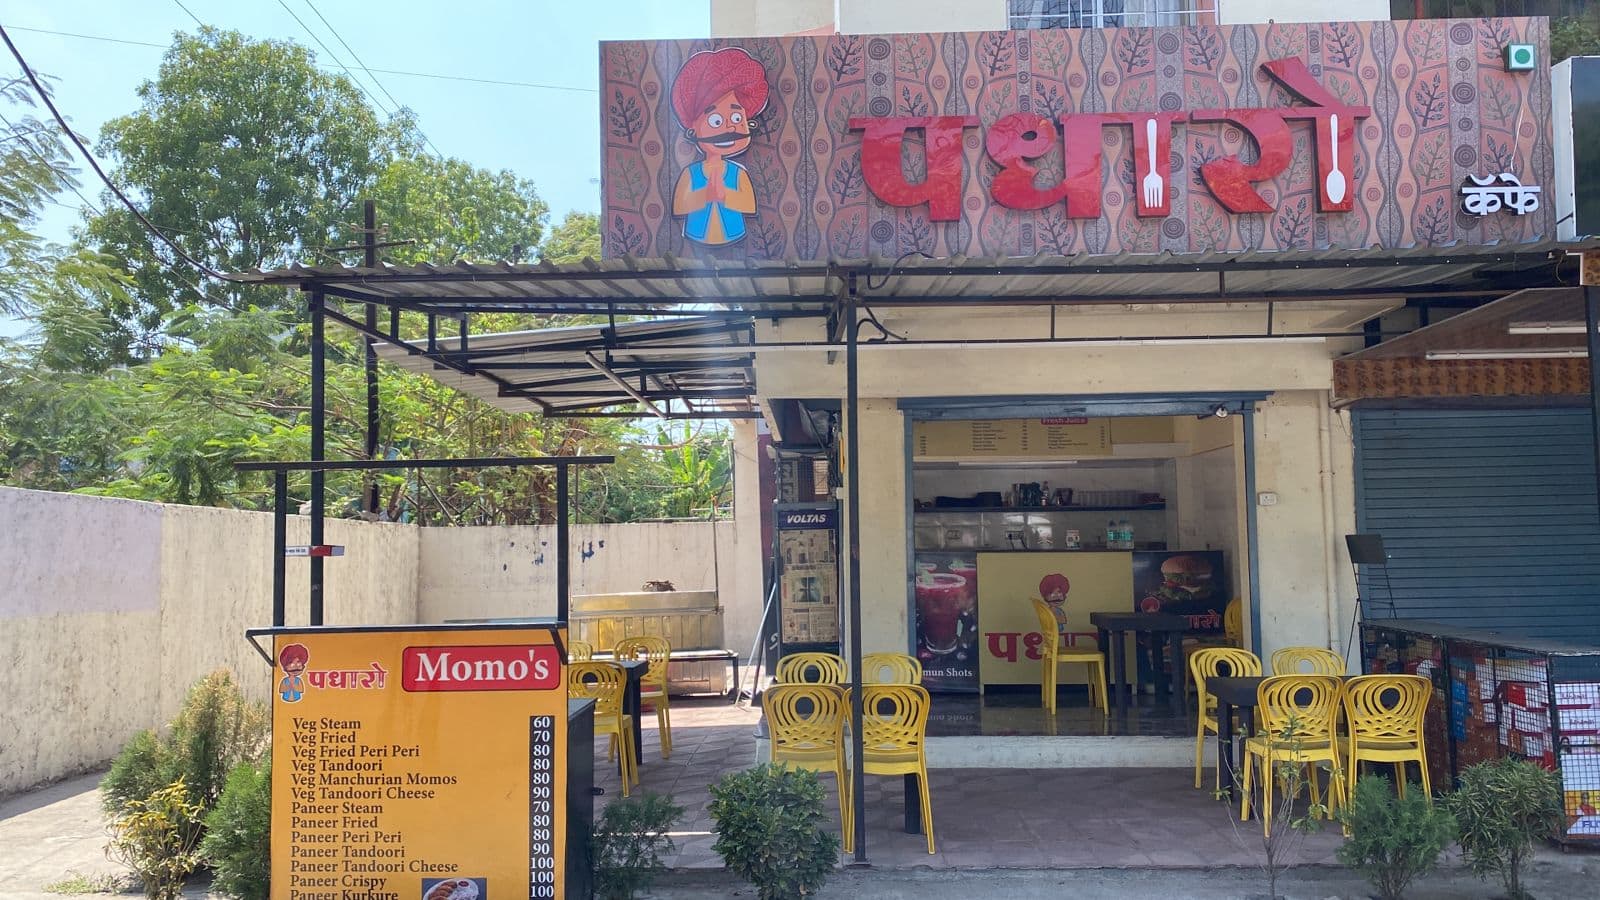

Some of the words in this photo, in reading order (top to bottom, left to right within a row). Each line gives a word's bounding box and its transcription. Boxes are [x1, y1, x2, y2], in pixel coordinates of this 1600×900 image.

[849, 57, 1370, 221] पधारो
[787, 514, 827, 524] VOLTAS
[415, 649, 549, 682] Momo's
[922, 668, 944, 677] mun
[946, 667, 973, 677] Shots
[308, 663, 387, 689] पधारो
[293, 718, 316, 733] Veg
[320, 717, 361, 730] Steam
[533, 716, 550, 728] 60
[293, 732, 316, 747] Veg
[320, 731, 356, 744] Fried
[533, 730, 550, 743] 70
[292, 746, 316, 761] Veg
[320, 745, 356, 758] Fried
[360, 745, 387, 758] Peri
[392, 745, 419, 758] Peri
[533, 744, 550, 757] 80
[292, 760, 316, 775] Veg
[320, 759, 383, 772] Tandoori
[533, 758, 550, 771] 80
[292, 774, 316, 789] Veg
[319, 773, 402, 786] Manchurian
[407, 773, 457, 786] Momos
[533, 772, 550, 785] 80
[291, 788, 315, 803] Veg
[319, 787, 382, 800] Tandoori
[386, 787, 435, 800] Cheese
[533, 786, 550, 799] 90
[292, 801, 339, 814] Paneer
[342, 801, 383, 814] Steam
[533, 800, 550, 813] 70
[292, 816, 338, 829] Paneer
[342, 816, 378, 829] Fried
[533, 814, 550, 827] 80
[291, 830, 338, 843] Paneer
[342, 830, 369, 843] Peri
[374, 830, 401, 843] Peri
[533, 828, 550, 841] 80
[291, 845, 338, 858] Paneer
[342, 845, 405, 858] Tandoori
[533, 842, 550, 855] 90
[291, 860, 338, 873] Paneer
[342, 860, 405, 873] Tandoori
[409, 860, 458, 873] Cheese
[530, 856, 554, 869] 100
[290, 875, 338, 888] Paneer
[342, 874, 387, 890] Crispy
[530, 871, 554, 883] 100
[291, 889, 338, 900] Paneer
[342, 889, 399, 900] Kurkure
[530, 885, 554, 898] 100
